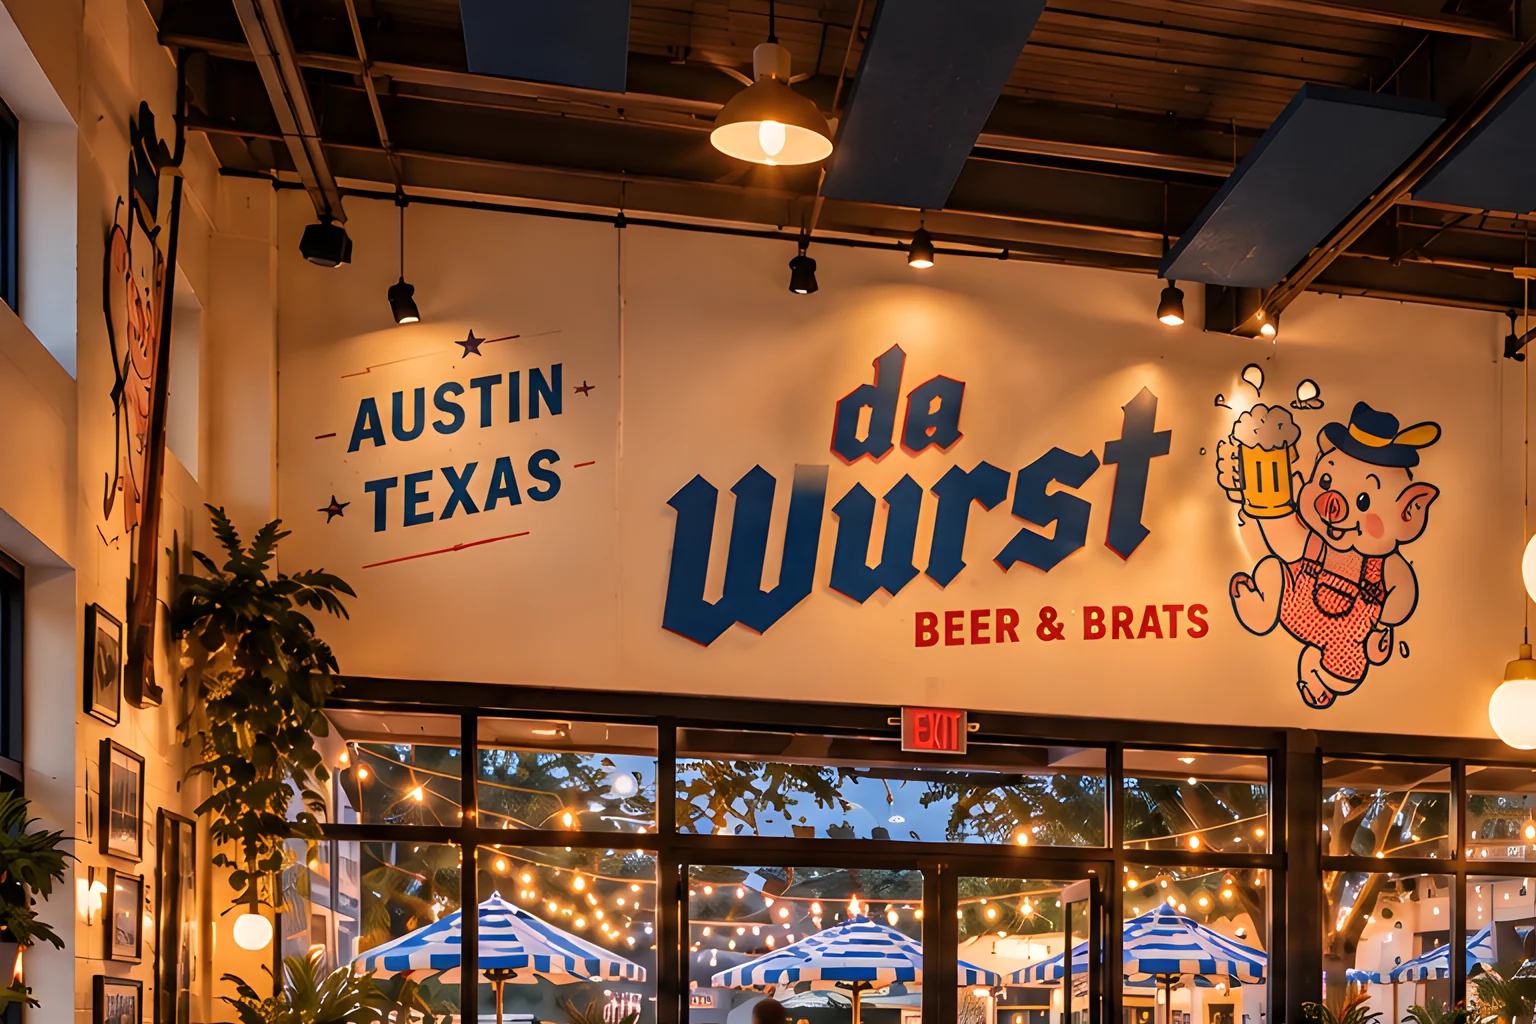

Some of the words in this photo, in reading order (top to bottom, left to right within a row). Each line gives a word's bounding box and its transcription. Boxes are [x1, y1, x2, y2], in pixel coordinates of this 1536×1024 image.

[347, 362, 563, 453] AUSTIN
[829, 343, 966, 464] da
[364, 449, 562, 532] TEXAS
[661, 386, 1172, 648] Wurst
[914, 607, 1020, 648] BEER
[1034, 605, 1065, 641] &
[1082, 603, 1210, 642] BRATS
[912, 709, 961, 750] EXIT
